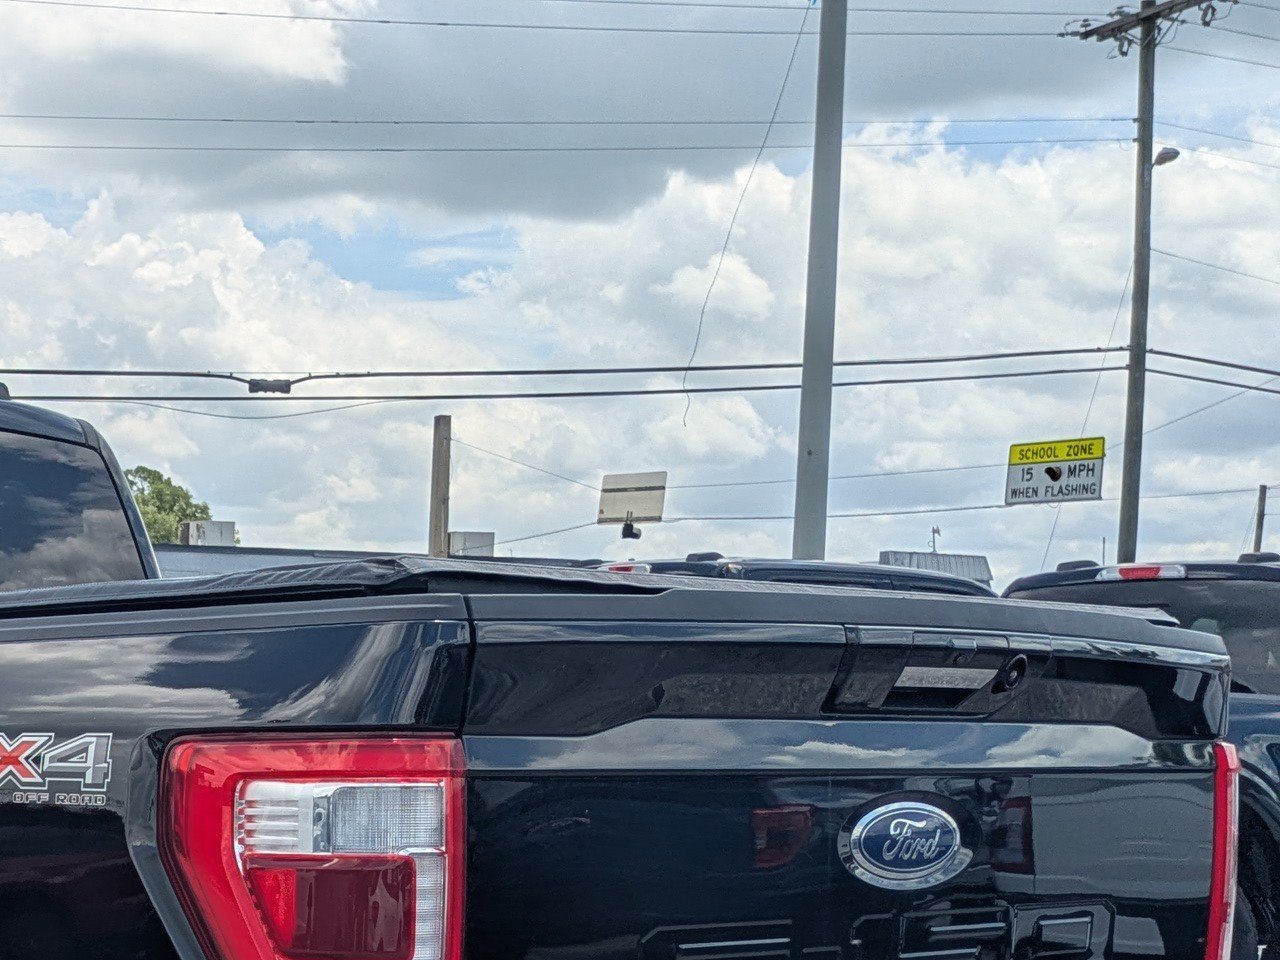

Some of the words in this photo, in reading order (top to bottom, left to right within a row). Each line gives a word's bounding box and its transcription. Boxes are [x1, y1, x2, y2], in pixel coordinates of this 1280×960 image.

[1018, 446, 1059, 461] SCHOOL
[1066, 443, 1094, 457] ZONE
[1021, 468, 1034, 482] 15
[1067, 463, 1095, 479] MPH
[1010, 486, 1039, 499] WHEN
[1044, 483, 1097, 498] FLASHING
[12, 791, 50, 804] OFF
[54, 792, 107, 806] ROAD
[882, 818, 941, 861] Ford
